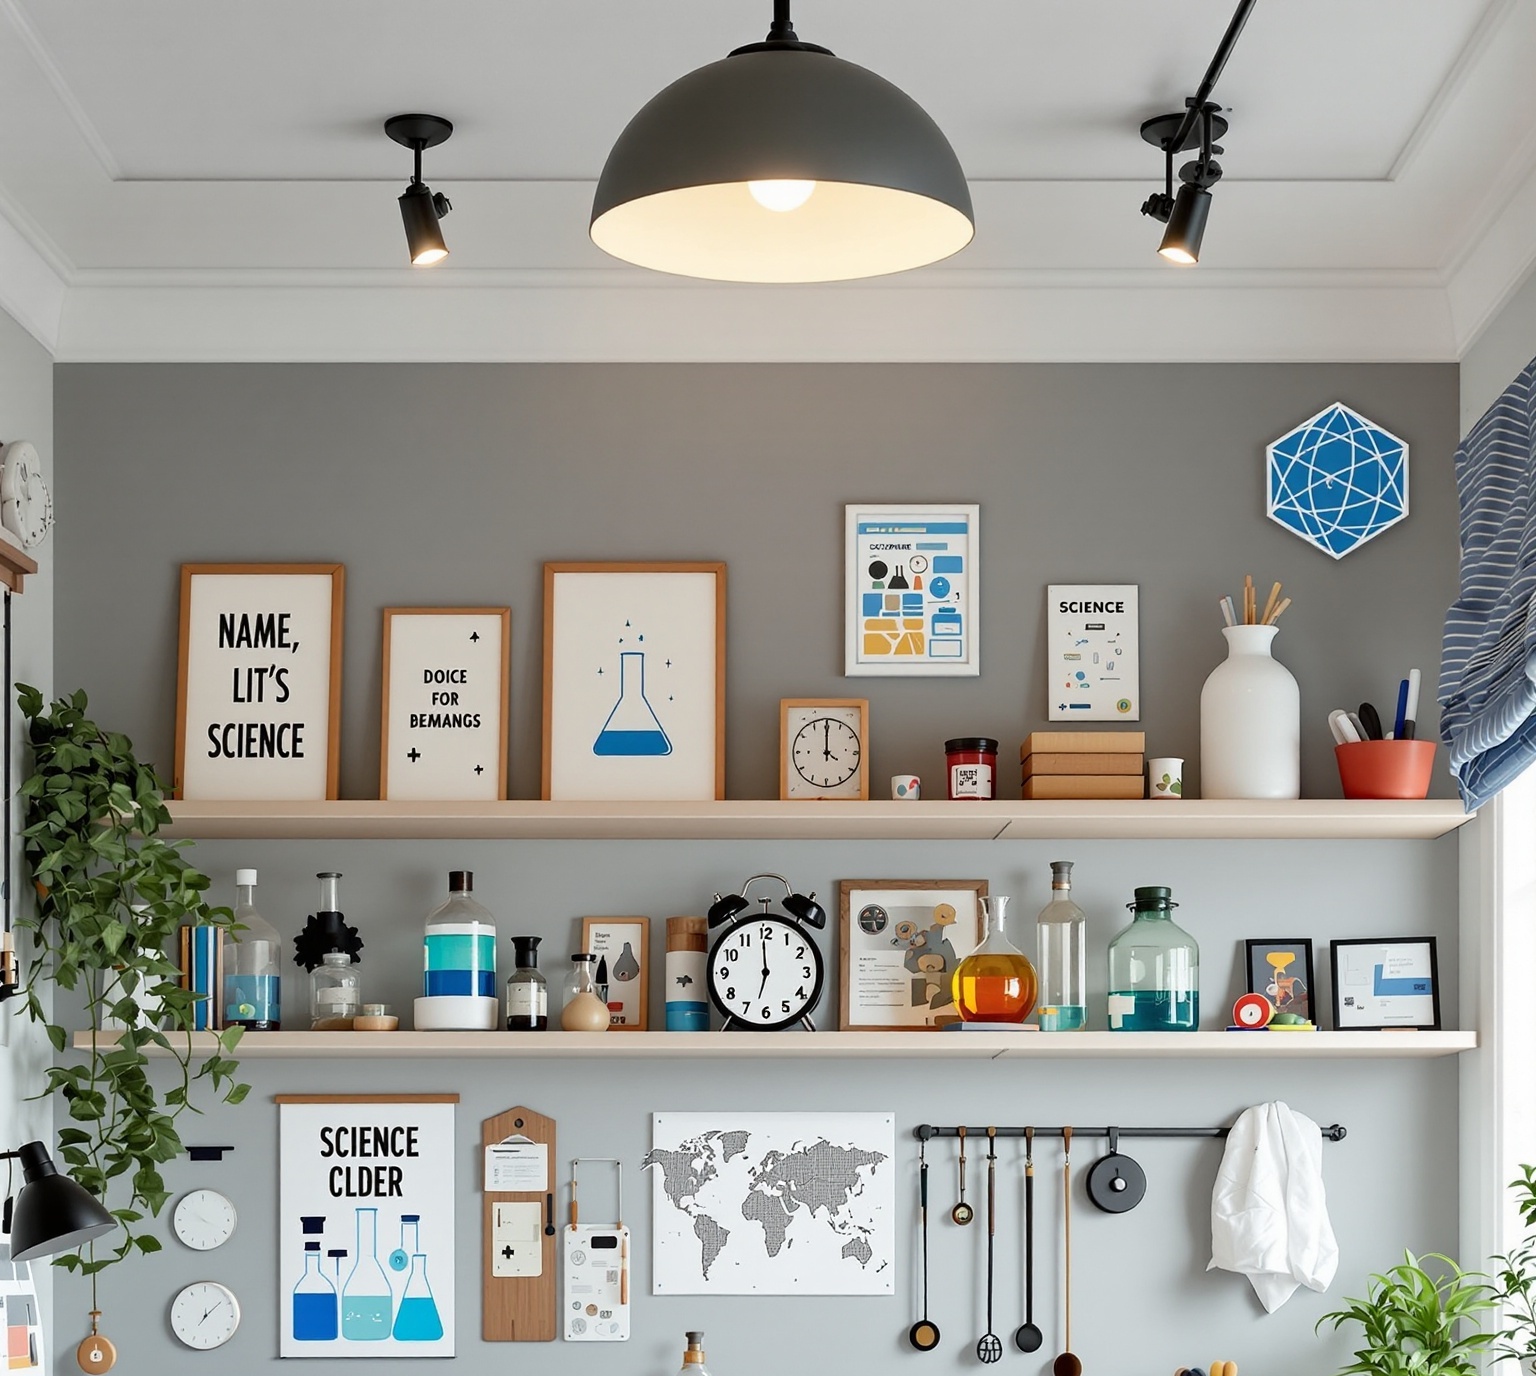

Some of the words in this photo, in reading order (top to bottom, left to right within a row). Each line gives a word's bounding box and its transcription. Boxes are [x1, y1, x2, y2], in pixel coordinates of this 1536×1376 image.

[1060, 602, 1124, 613] SCIENCE
[219, 614, 299, 653] NAME,
[234, 664, 289, 702] LIT'S
[424, 670, 467, 683] DOICE
[433, 692, 458, 705] FOR
[411, 714, 480, 728] BEMANGS
[208, 723, 304, 758] SCIENCE
[739, 933, 750, 947] 11
[759, 927, 773, 940] 12
[784, 933, 789, 946] 1
[724, 949, 738, 961] 10
[795, 947, 805, 959] 2
[720, 967, 730, 980] 9
[802, 966, 811, 979] 3
[726, 987, 736, 1000] 8
[795, 986, 807, 1000] 4
[742, 1001, 751, 1015] 7
[761, 1006, 771, 1019] 6
[781, 1000, 790, 1013] 5
[321, 1127, 418, 1157] SCIENCE
[330, 1166, 402, 1197] CLDER
